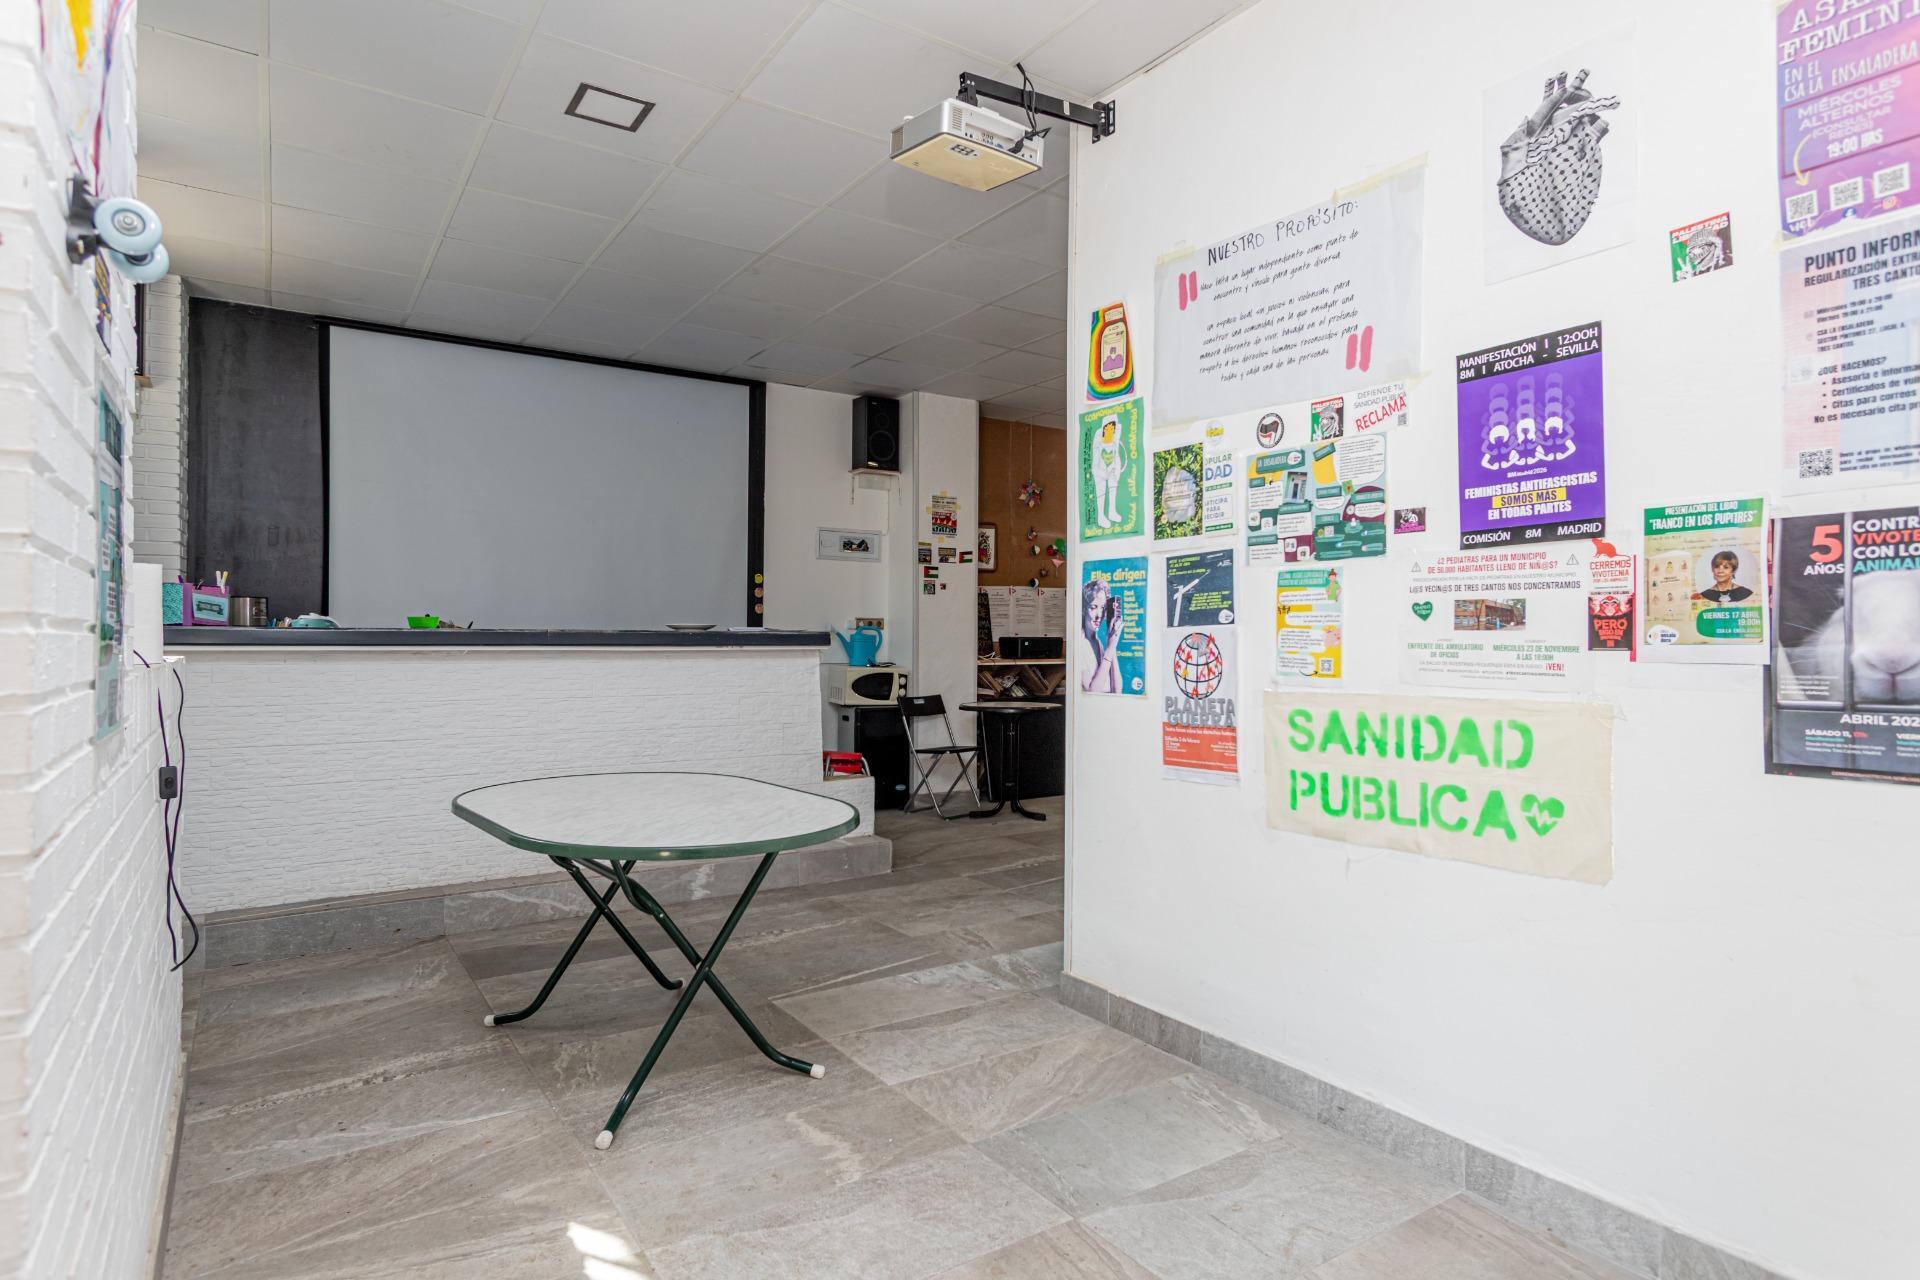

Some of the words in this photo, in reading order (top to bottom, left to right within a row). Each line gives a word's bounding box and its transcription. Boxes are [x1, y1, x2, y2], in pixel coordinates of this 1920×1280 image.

[1784, 82, 1806, 102] CSA
[1809, 76, 1824, 95] LA
[1831, 40, 1918, 87] ENSALADERA
[1784, 66, 1802, 86] EN
[1807, 60, 1821, 77] EL
[1797, 73, 1902, 119] MIÉRCOLES
[1799, 90, 1895, 132] ALTERNOS
[1208, 233, 1264, 266] NUESTRO
[1805, 246, 1856, 273] PUNTO
[1804, 258, 1888, 287] REGULARIZACIÓN
[1853, 274, 1880, 290] TRES
[1460, 341, 1536, 368] MANIFESTACIÓN
[1460, 368, 1474, 380] 8M
[1494, 354, 1534, 372] ATOCHA
[1556, 339, 1598, 358] SEVILLA
[1841, 356, 1887, 372] HACEMOS?
[1358, 386, 1392, 400] DEFIENDE
[1832, 382, 1886, 397] Certificados
[1856, 396, 1877, 406] para
[1880, 390, 1917, 401] correos
[1356, 396, 1406, 432] RECLAMA
[1828, 414, 1838, 422] es
[1840, 406, 1886, 420] necesario
[1205, 464, 1232, 482] DAD
[1465, 482, 1518, 499] FEMINISTAS
[1520, 471, 1598, 493] ANTIFASCISTAS
[1501, 494, 1534, 507] SOMOS
[1488, 509, 1500, 520] EN
[1501, 505, 1532, 519] TODAS
[1534, 500, 1572, 515] PARTES
[1685, 516, 1696, 528] EN
[1698, 514, 1712, 526] LOS
[1463, 530, 1510, 545] COMISIÓN
[1525, 528, 1542, 539] 8M
[1557, 522, 1602, 536] MADRID
[1809, 524, 1844, 564] 5
[1853, 544, 1894, 559] CON
[1898, 542, 1920, 556] LO
[1446, 555, 1479, 564] PEDIATRAS
[1481, 554, 1498, 562] PARA
[1500, 554, 1508, 562] UN
[1510, 552, 1547, 561] MUNICIPIO
[1590, 560, 1632, 570] CERREMOS
[1090, 570, 1112, 582] Ellas
[1113, 568, 1146, 583] dirigen
[1428, 566, 1436, 574] DE
[1458, 564, 1494, 574] HABITANTES
[1496, 562, 1516, 572] LLENO
[1518, 562, 1527, 570] DE
[1592, 570, 1630, 578] VIVOTECNIA
[1804, 561, 1845, 576] AÑOS
[1425, 584, 1452, 594] VECIN@S
[1464, 584, 1479, 592] TRES
[1481, 583, 1506, 592] CANTOS
[1508, 582, 1522, 590] NOS
[1524, 580, 1581, 590] CONCENTRAMOS
[1594, 618, 1628, 630] PERO
[1165, 696, 1236, 717] PLANETA
[1168, 708, 1234, 728] GUERRA
[1840, 714, 1888, 726] ABRIL
[1288, 708, 1534, 770] SANIDAD
[1805, 728, 1842, 736] SÁBADO
[1290, 769, 1518, 842] PUBLICA
